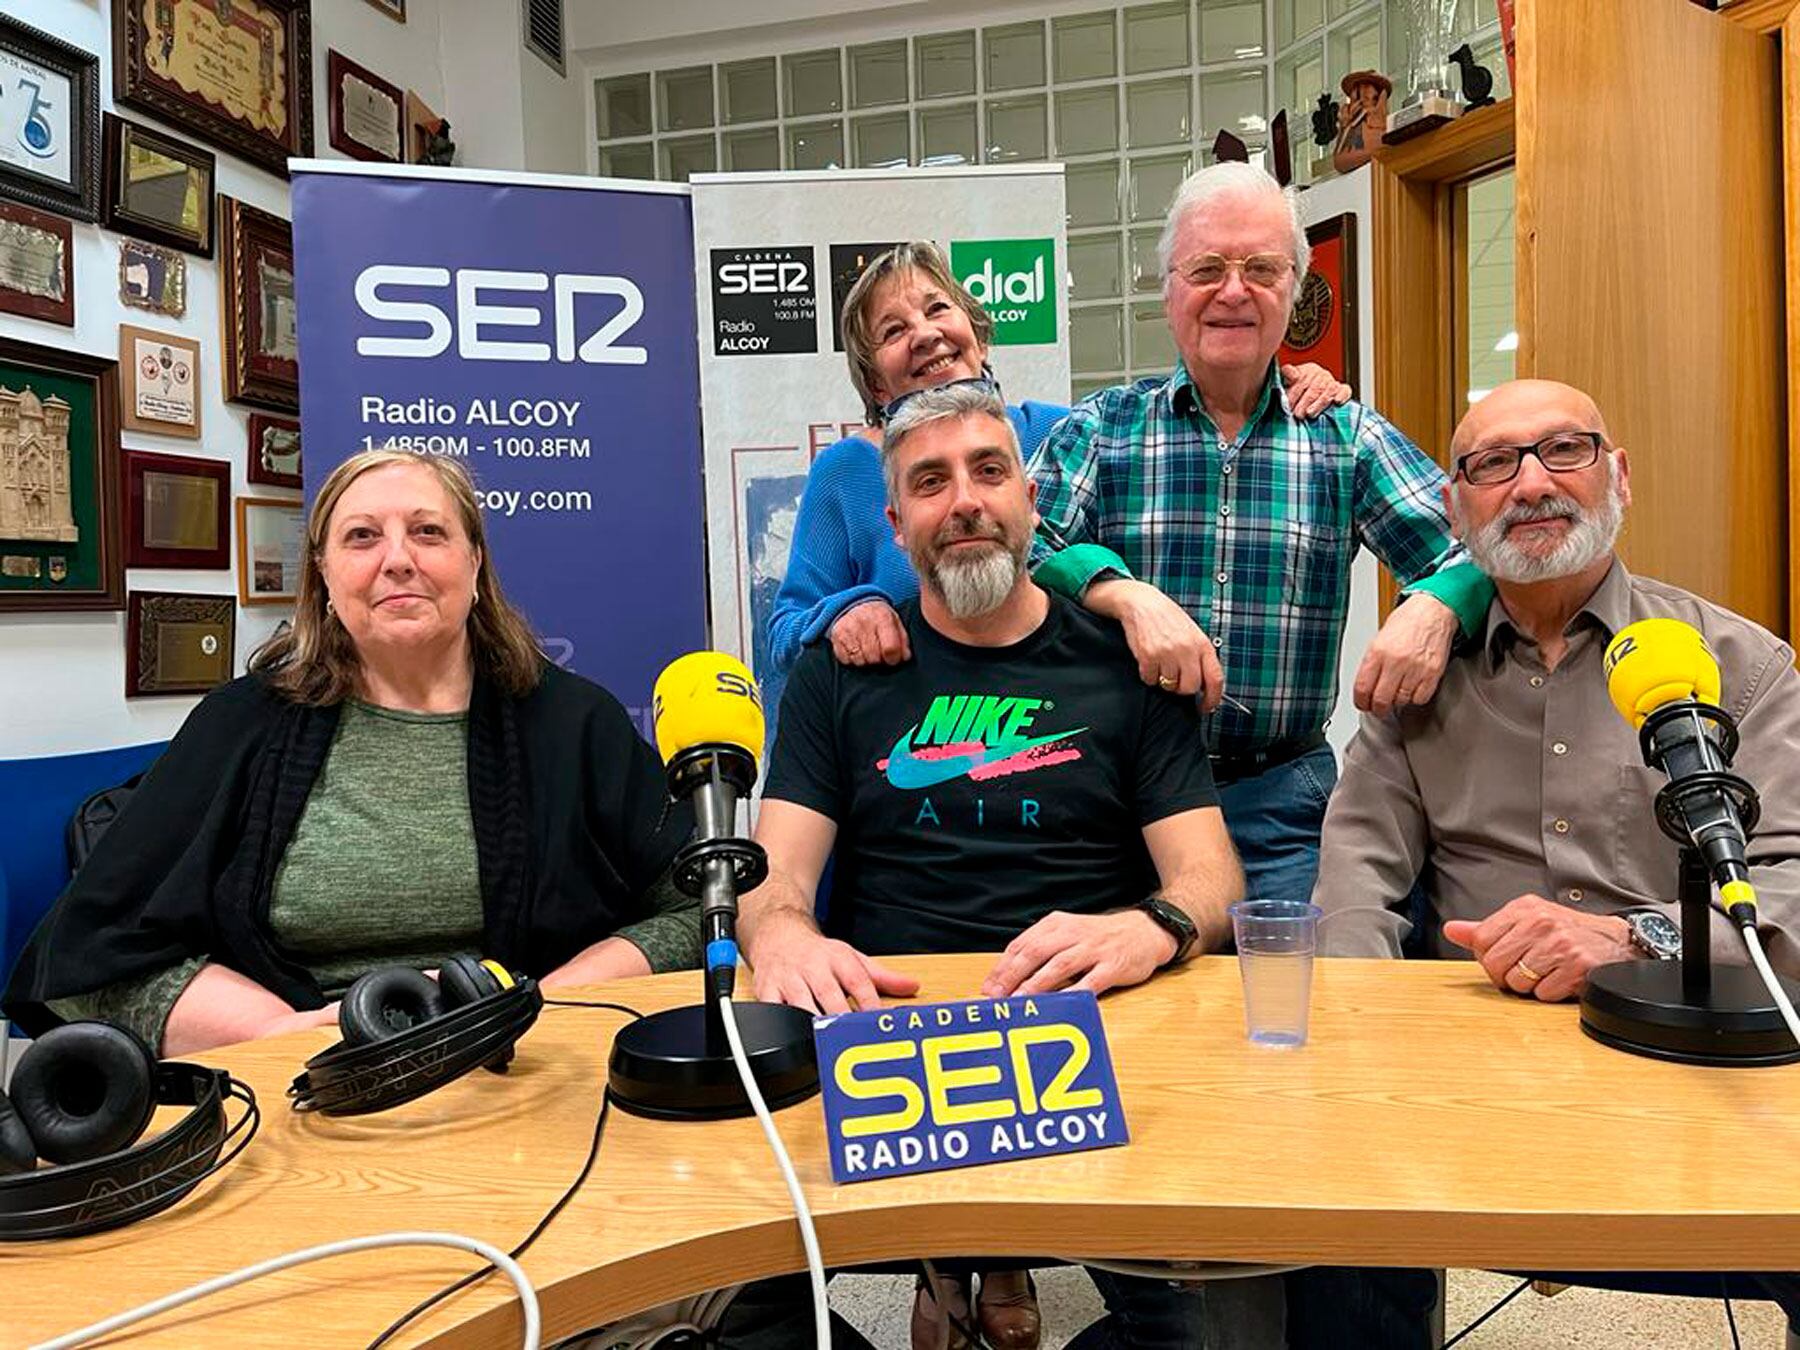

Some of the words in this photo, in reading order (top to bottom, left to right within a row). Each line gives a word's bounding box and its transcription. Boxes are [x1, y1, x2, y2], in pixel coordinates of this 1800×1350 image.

[734, 252, 792, 262] CADENA
[718, 262, 809, 295] SER
[963, 254, 1045, 305] dial
[354, 264, 648, 365] SER
[719, 320, 756, 333] Radio
[986, 309, 1028, 323] LCOY
[720, 337, 770, 351] ALCOY
[361, 396, 457, 425] Radio
[465, 399, 581, 427] ALCOY
[492, 437, 591, 458] 100.8FM
[912, 695, 1043, 748] NIKE
[914, 796, 1041, 828] AIR
[878, 999, 1039, 1032] CADENA
[833, 1023, 1104, 1138] SER
[844, 1130, 970, 1173] RADIO
[990, 1111, 1109, 1154] ALCOY
